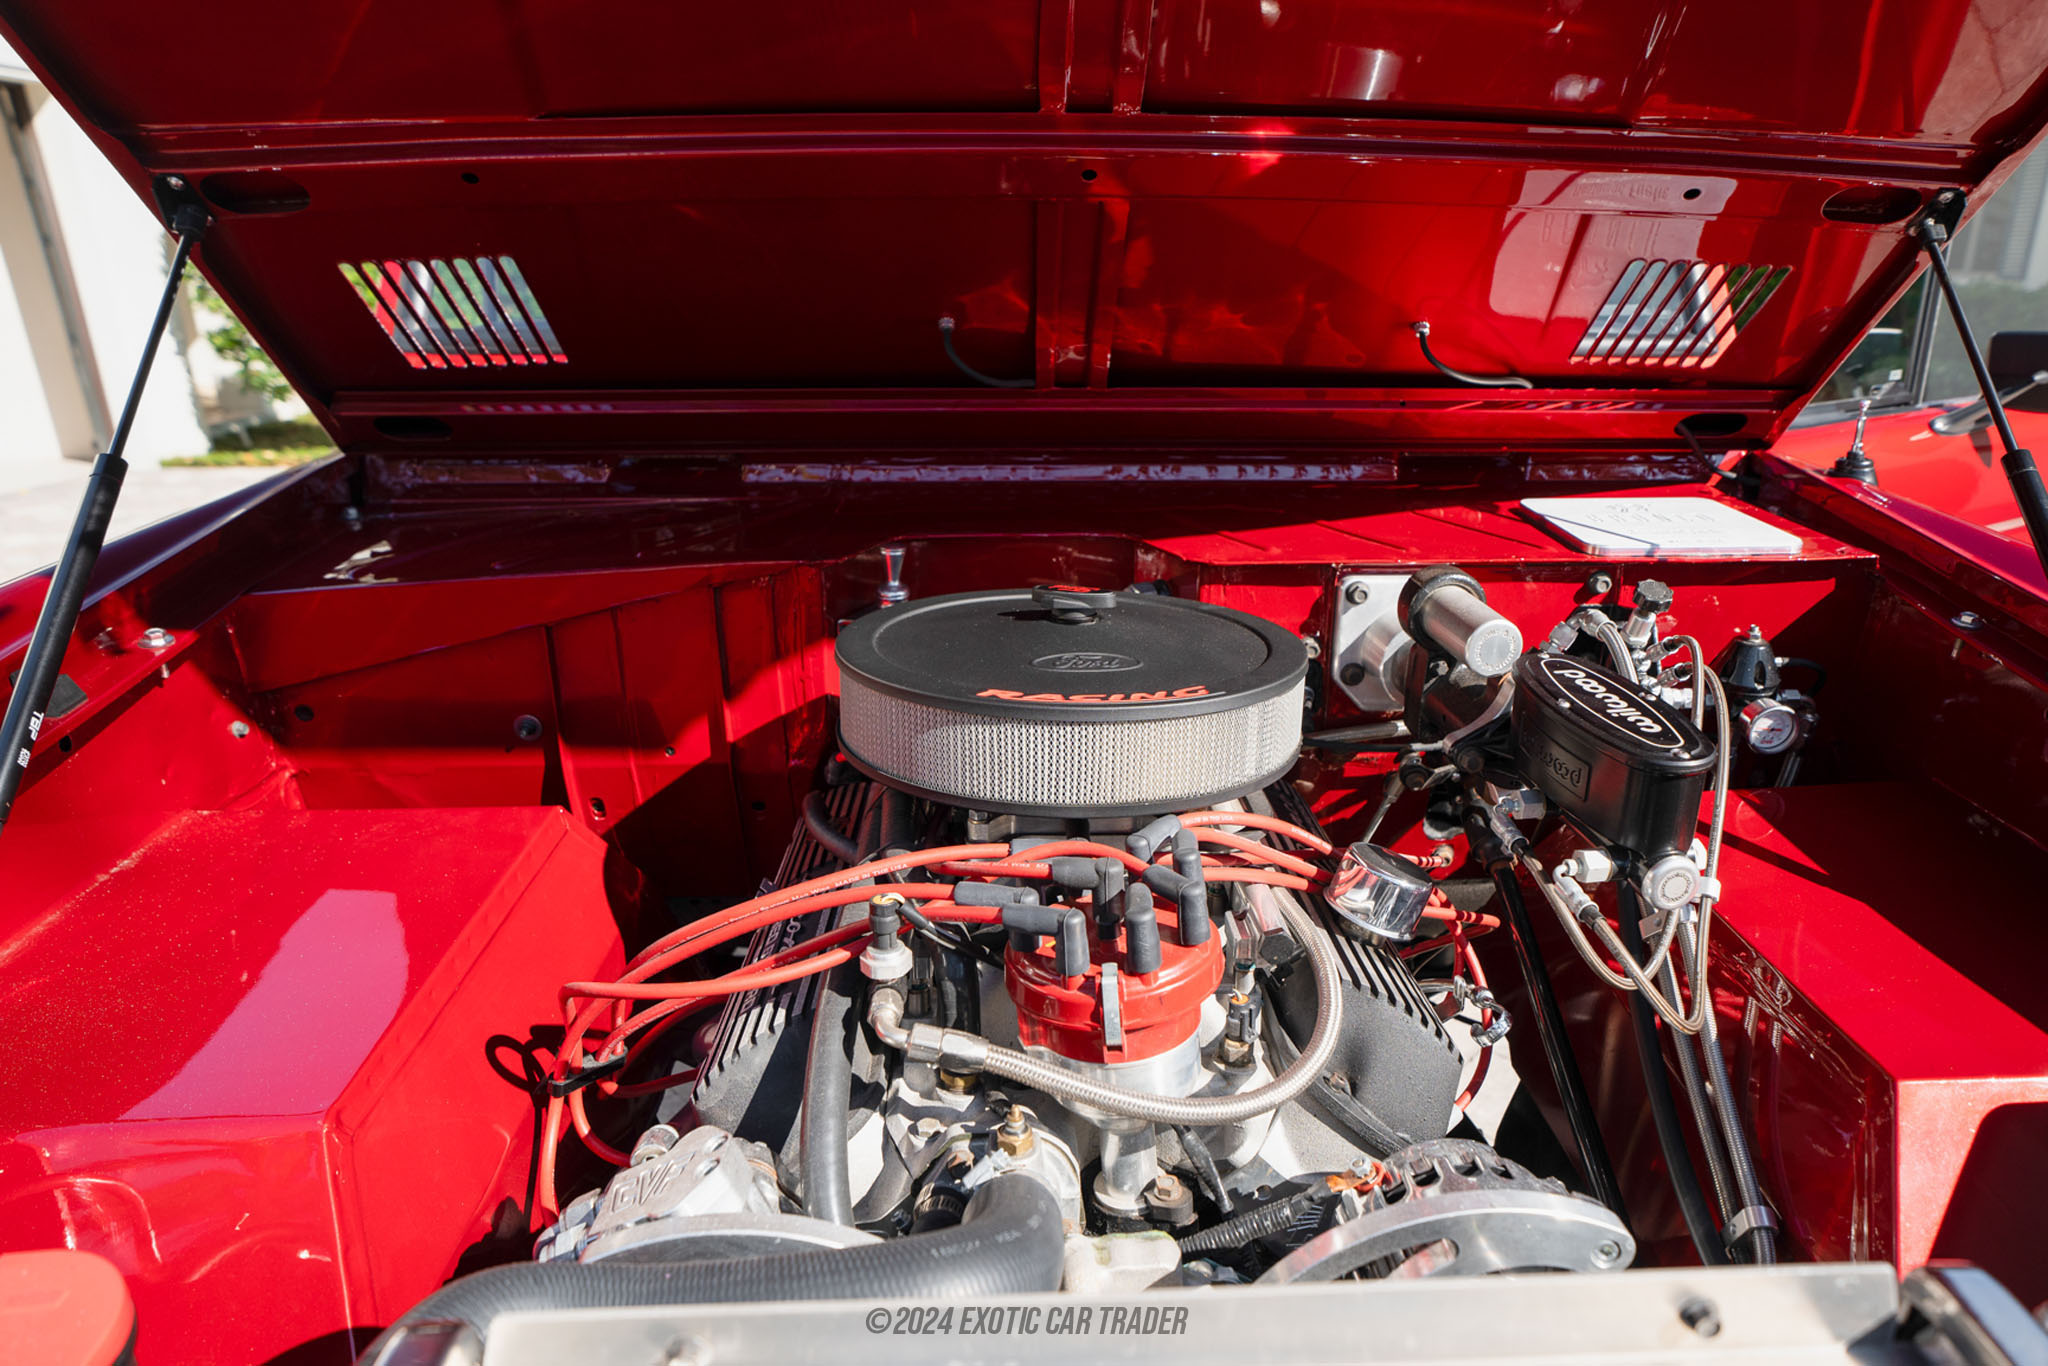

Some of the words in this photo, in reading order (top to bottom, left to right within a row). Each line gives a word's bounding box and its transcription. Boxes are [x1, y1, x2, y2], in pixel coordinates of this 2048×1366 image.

[1056, 655, 1120, 668] Ford
[977, 685, 1210, 702] RACING
[1553, 669, 1663, 734] wilwood
[835, 875, 860, 888] MADE
[872, 867, 889, 877] THE
[890, 863, 908, 873] USA
